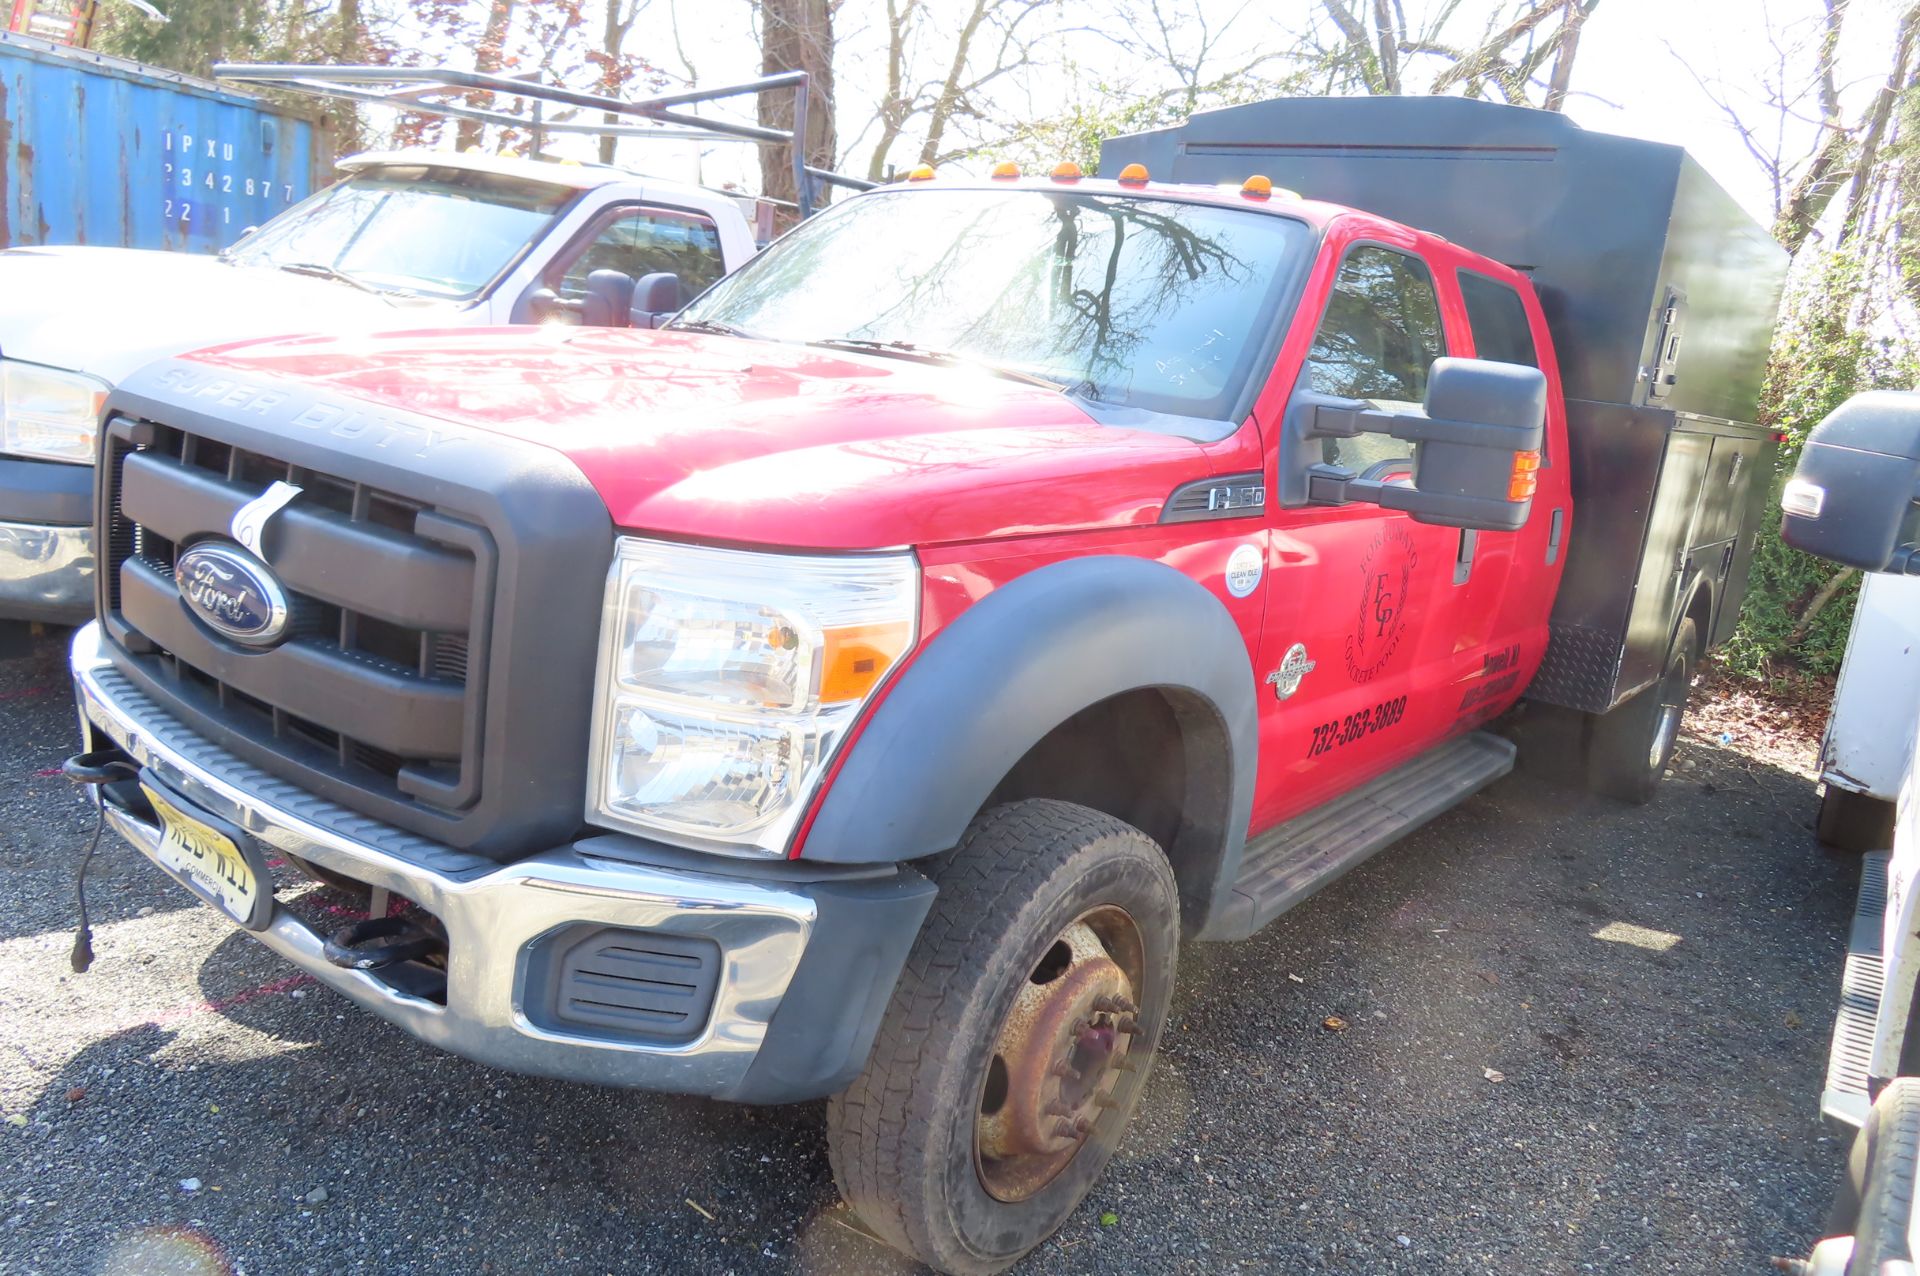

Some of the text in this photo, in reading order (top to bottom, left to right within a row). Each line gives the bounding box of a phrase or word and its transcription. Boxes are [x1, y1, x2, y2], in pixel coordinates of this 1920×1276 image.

[152, 368, 469, 459] SUPER DUTY
[1360, 521, 1418, 575] FORTUNATO
[189, 560, 246, 622] Ford
[1345, 633, 1374, 685] CONCRETE
[1306, 695, 1407, 759] 732-363-3889
[185, 862, 225, 897] COMMERCIAL
